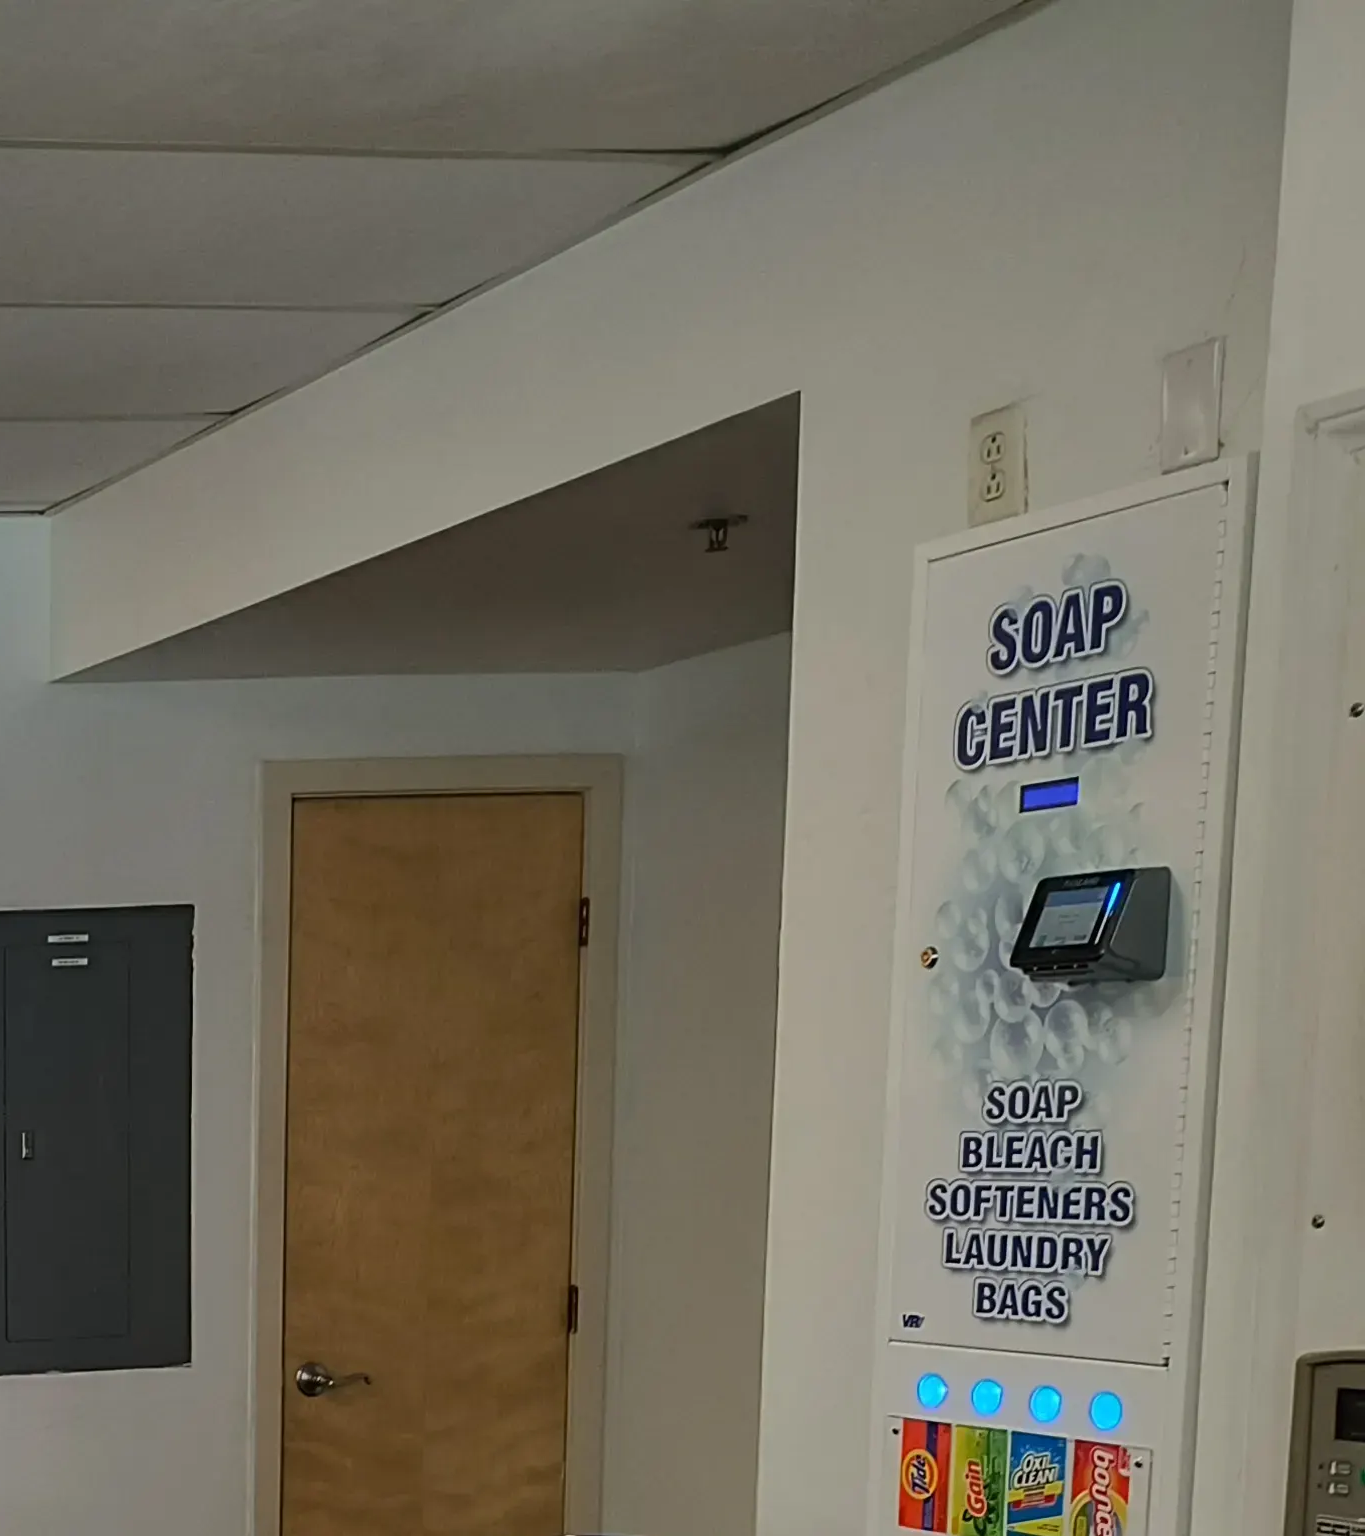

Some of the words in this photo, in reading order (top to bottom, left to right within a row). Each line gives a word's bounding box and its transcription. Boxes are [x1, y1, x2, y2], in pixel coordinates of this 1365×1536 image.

[989, 581, 1126, 674] SOAP
[956, 669, 1152, 769] CENTER
[985, 1081, 1081, 1122] SOAP
[960, 1132, 1101, 1171] BLEACH
[927, 1182, 1133, 1224] SOFTENERS
[943, 1230, 1110, 1274] LAUNDRY
[974, 1279, 1068, 1321] BAGS
[911, 1453, 931, 1494] Tide
[1013, 1467, 1058, 1489] CLEAN
[1021, 1453, 1051, 1473] OXI
[967, 1460, 987, 1517] Gain
